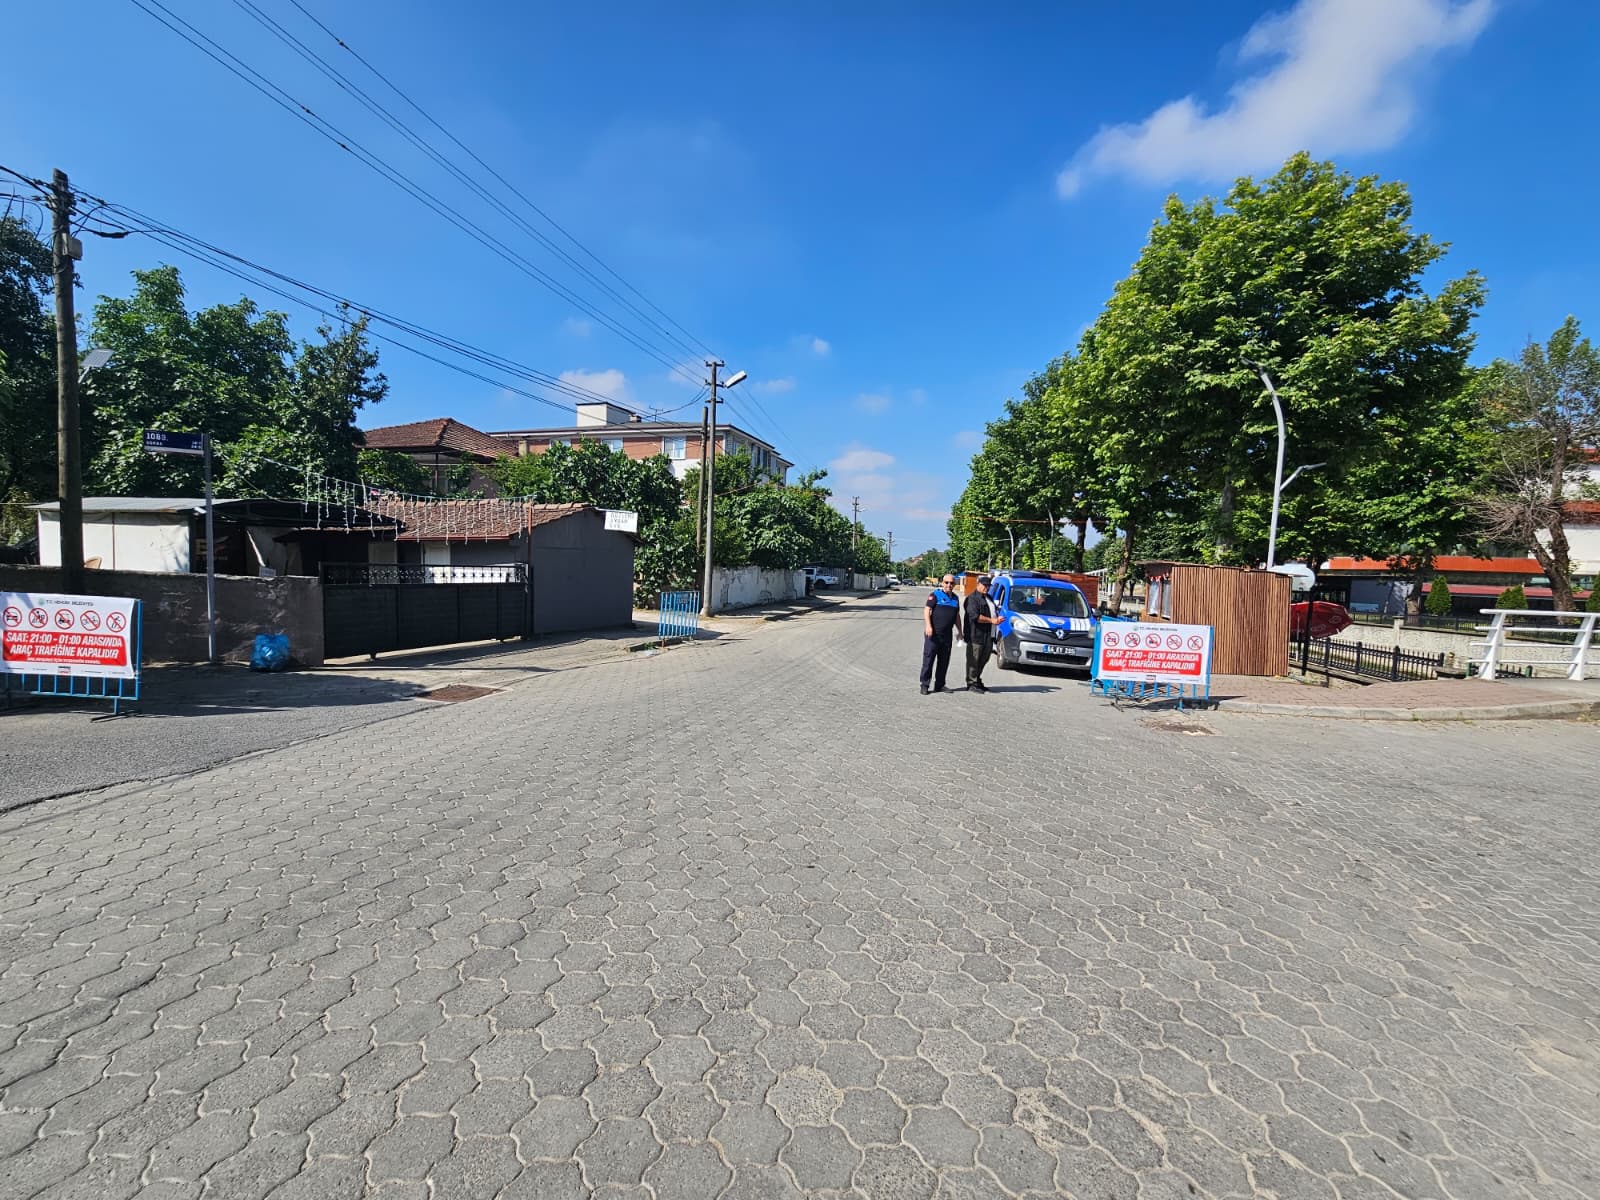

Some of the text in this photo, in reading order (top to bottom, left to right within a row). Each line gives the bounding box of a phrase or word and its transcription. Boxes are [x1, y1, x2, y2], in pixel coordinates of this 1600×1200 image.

[6, 632, 28, 643] SAAT:
[30, 633, 52, 643] 21:00
[82, 635, 123, 647] ARASINDA
[10, 644, 33, 656] ARAÇ
[35, 644, 75, 657] TRAFİĞİNE
[1109, 659, 1126, 669] ARAÇ
[1128, 659, 1161, 669] TRAFİĞİNE
